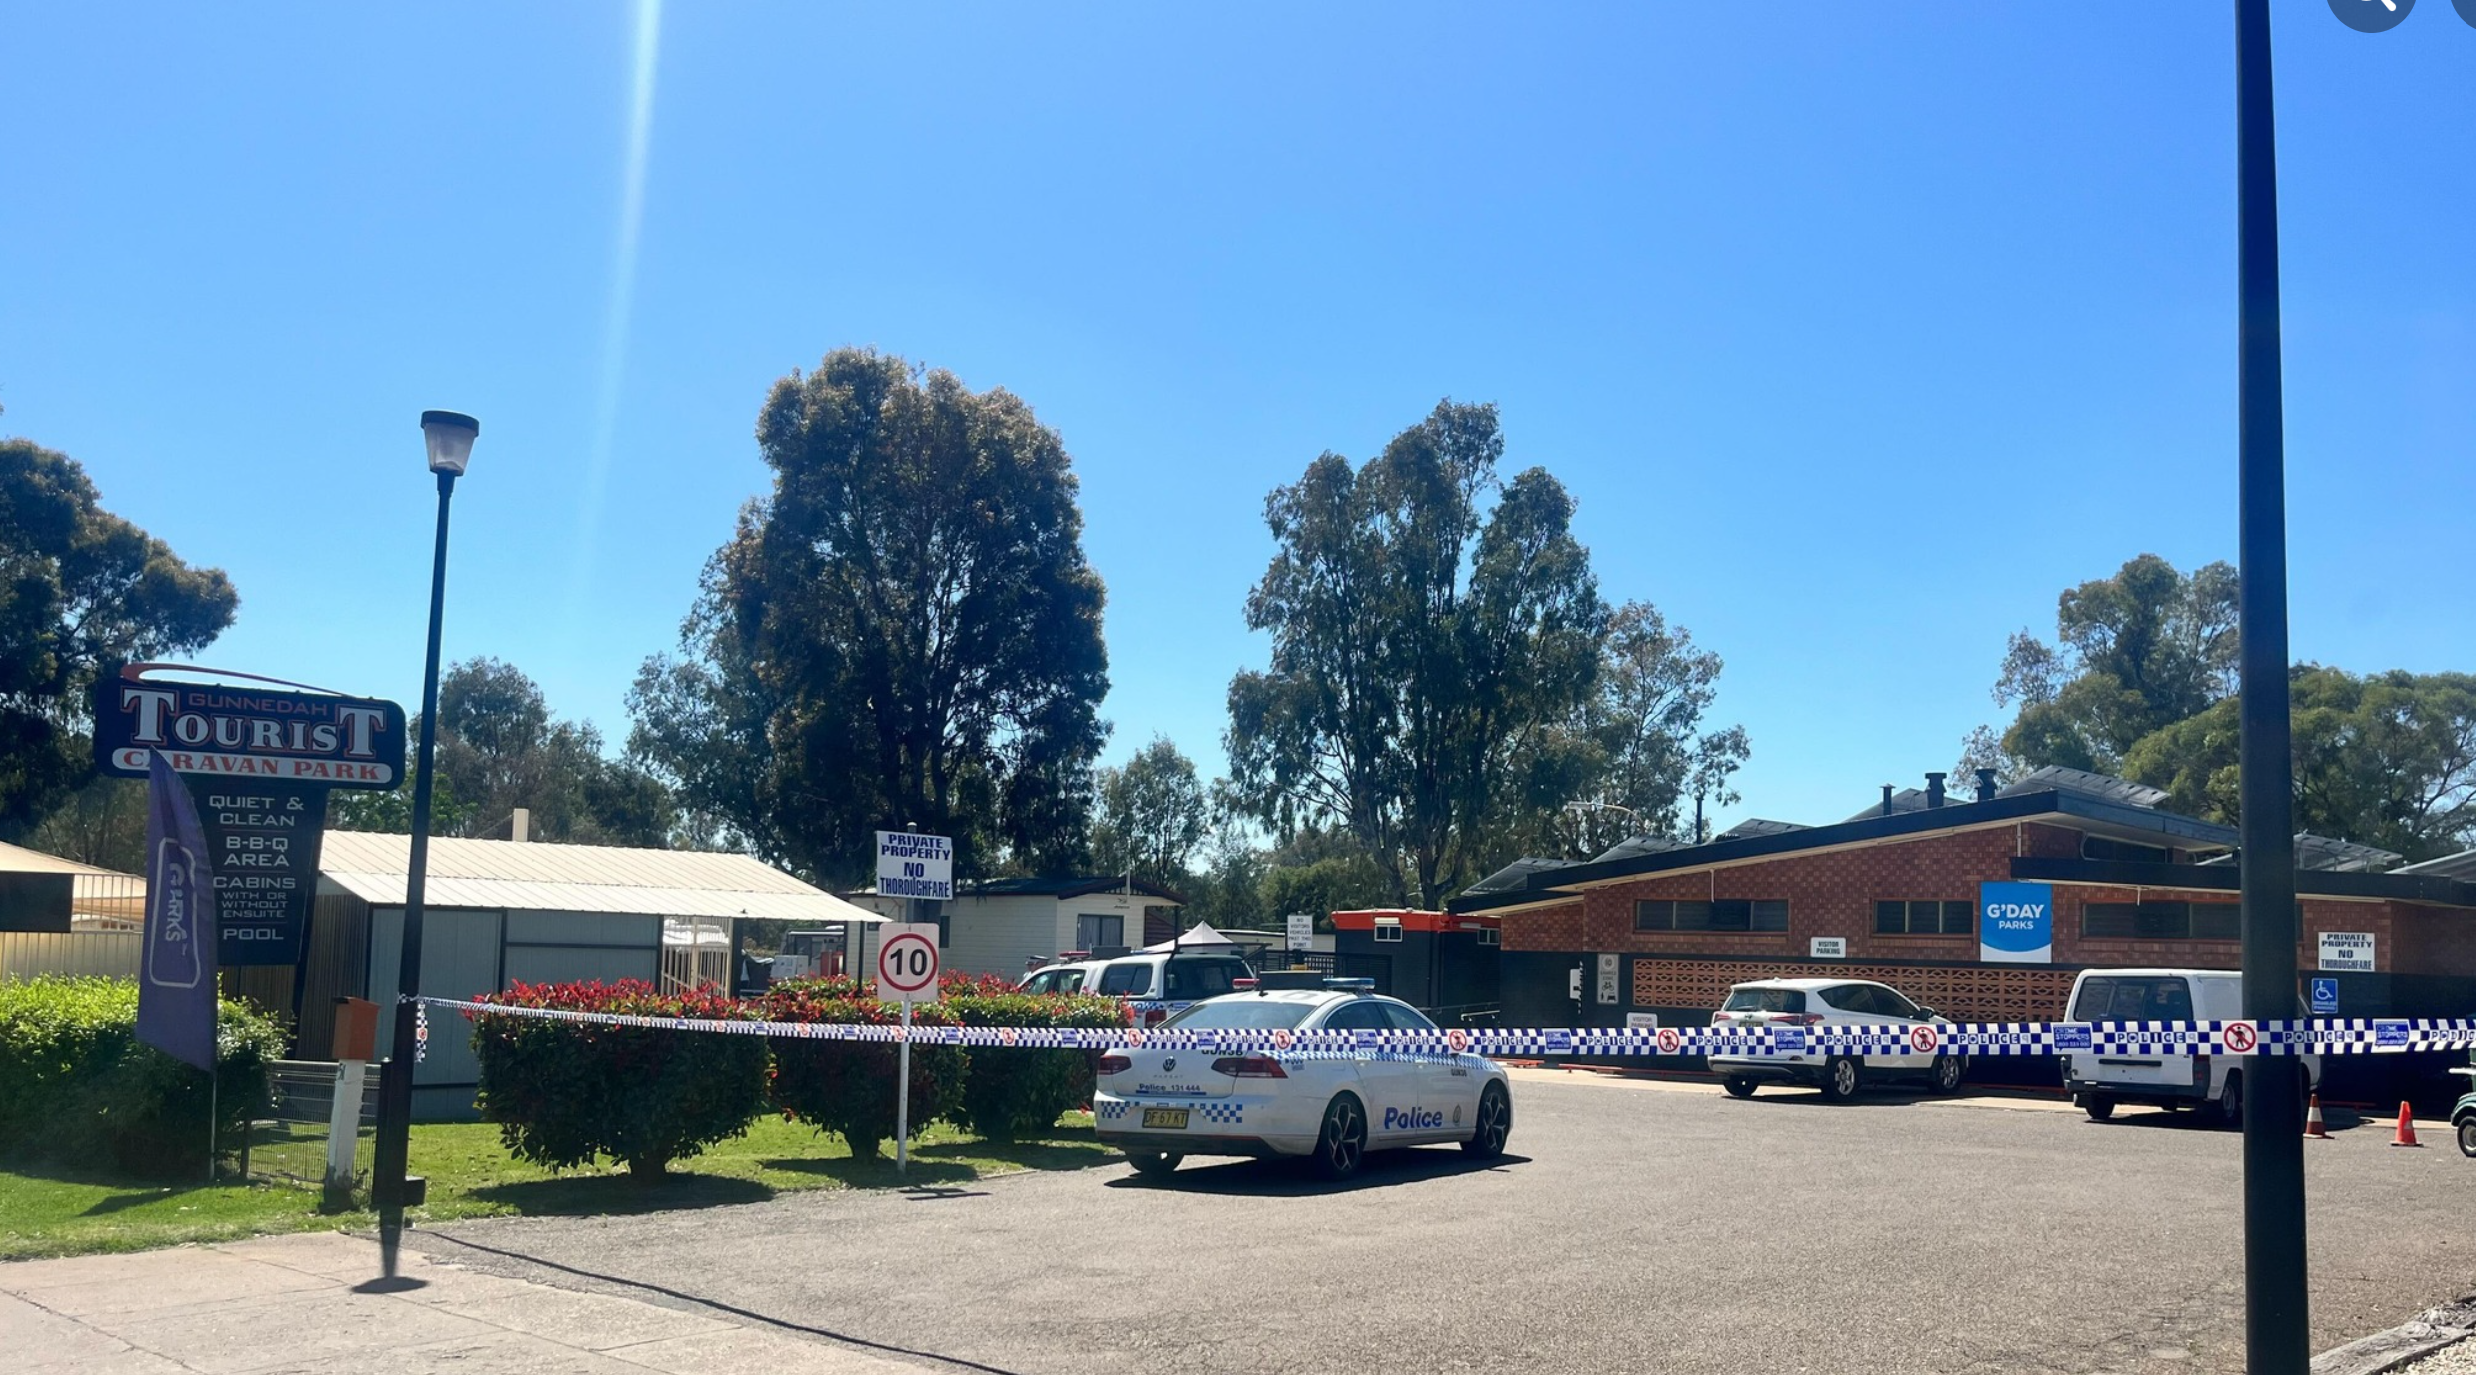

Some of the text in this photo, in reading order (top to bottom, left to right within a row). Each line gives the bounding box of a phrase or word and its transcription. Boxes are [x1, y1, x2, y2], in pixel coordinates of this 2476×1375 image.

[188, 692, 327, 716] GUNNEDAH
[123, 750, 380, 780] CRAVAN PARK
[209, 795, 304, 810] QUIET &
[219, 813, 295, 826] CLEAN
[226, 836, 288, 852] B-B-Q
[888, 834, 943, 849] PRIVATE
[881, 845, 951, 861] PROPERTY
[224, 853, 290, 866] AREA
[904, 862, 924, 878] NO
[213, 876, 296, 889] CABINS
[880, 877, 950, 898] THOROUGHFARE
[222, 891, 286, 900] WITH OR
[221, 900, 288, 909] WITHOUT
[223, 910, 285, 918] ENSUITE
[1986, 904, 2044, 918] G'DAY
[1998, 920, 2034, 930] PARKS
[223, 928, 284, 940] POOL
[2338, 950, 2354, 958] NO
[890, 948, 927, 976] 10
[2321, 959, 2372, 970] THOROUGHFARE
[1588, 1037, 1634, 1045] POLICE
[1698, 1037, 1748, 1045] POLICE
[1826, 1036, 1880, 1044] POLICE
[1960, 1034, 2018, 1044] POLICE
[2117, 1033, 2184, 1043] POLICE
[2285, 1032, 2344, 1042] POLICE
[1139, 1083, 1166, 1091] Police
[1384, 1106, 1443, 1129] Police
